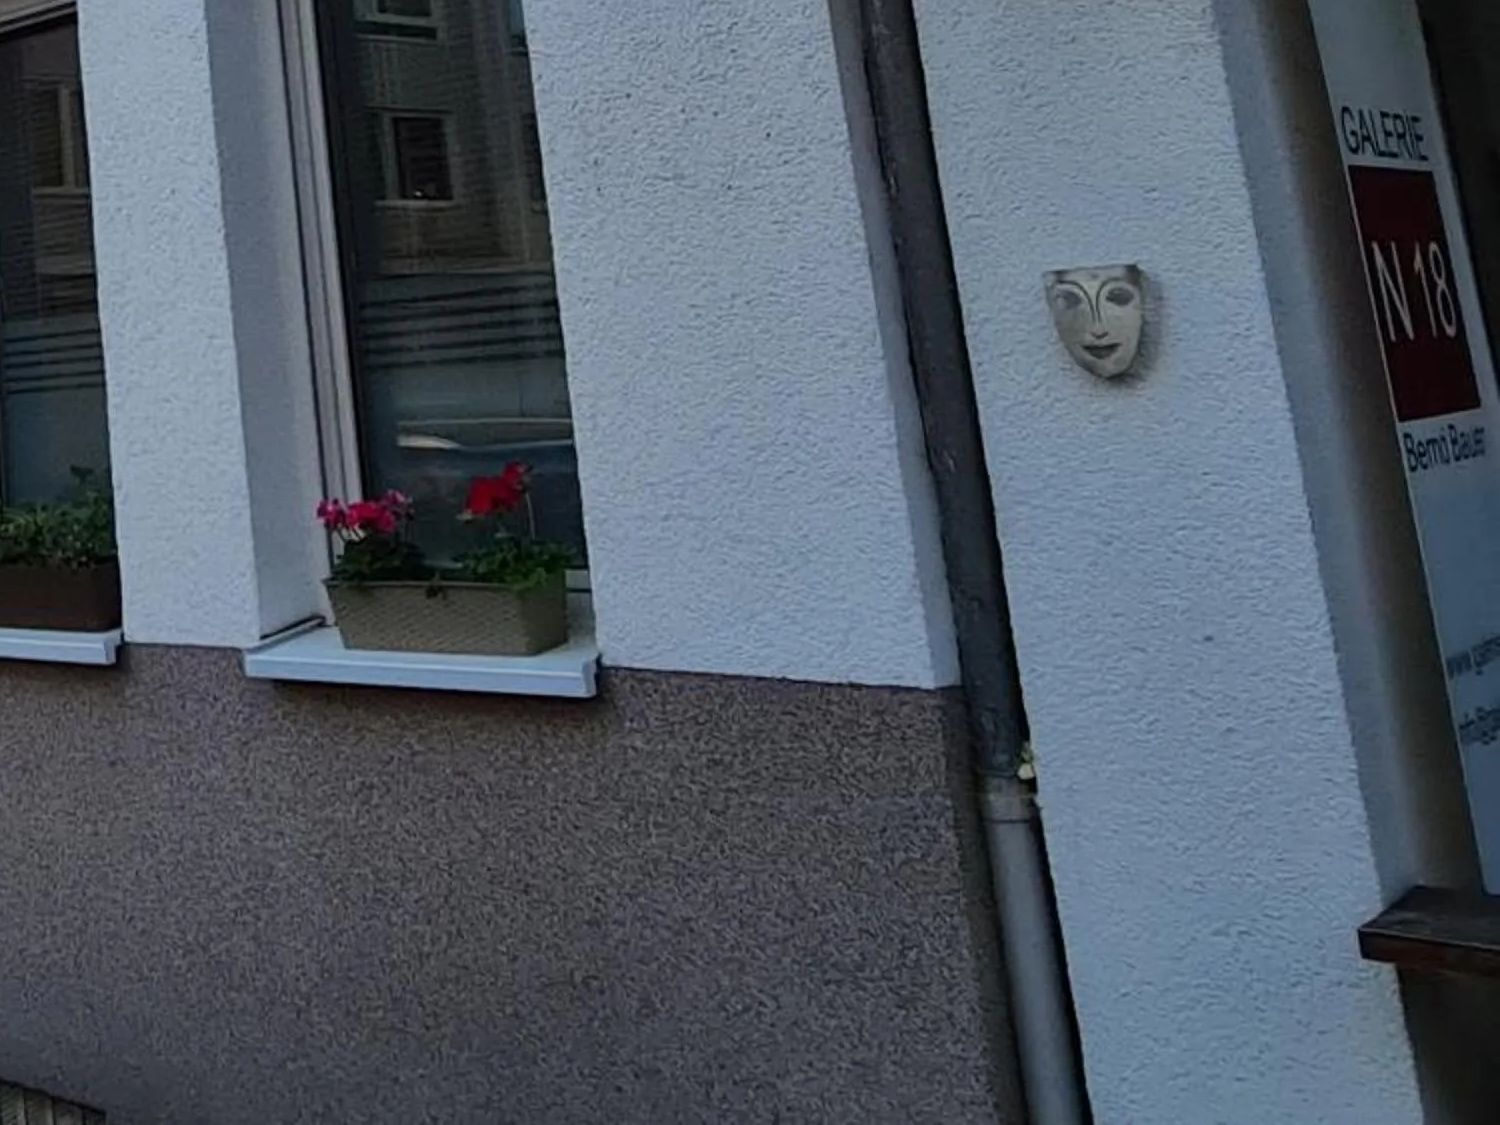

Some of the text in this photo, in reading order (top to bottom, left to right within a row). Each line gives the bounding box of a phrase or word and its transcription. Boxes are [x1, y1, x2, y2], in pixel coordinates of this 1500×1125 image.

[1341, 106, 1430, 162] GALERIE
[1371, 240, 1457, 343] N 18
